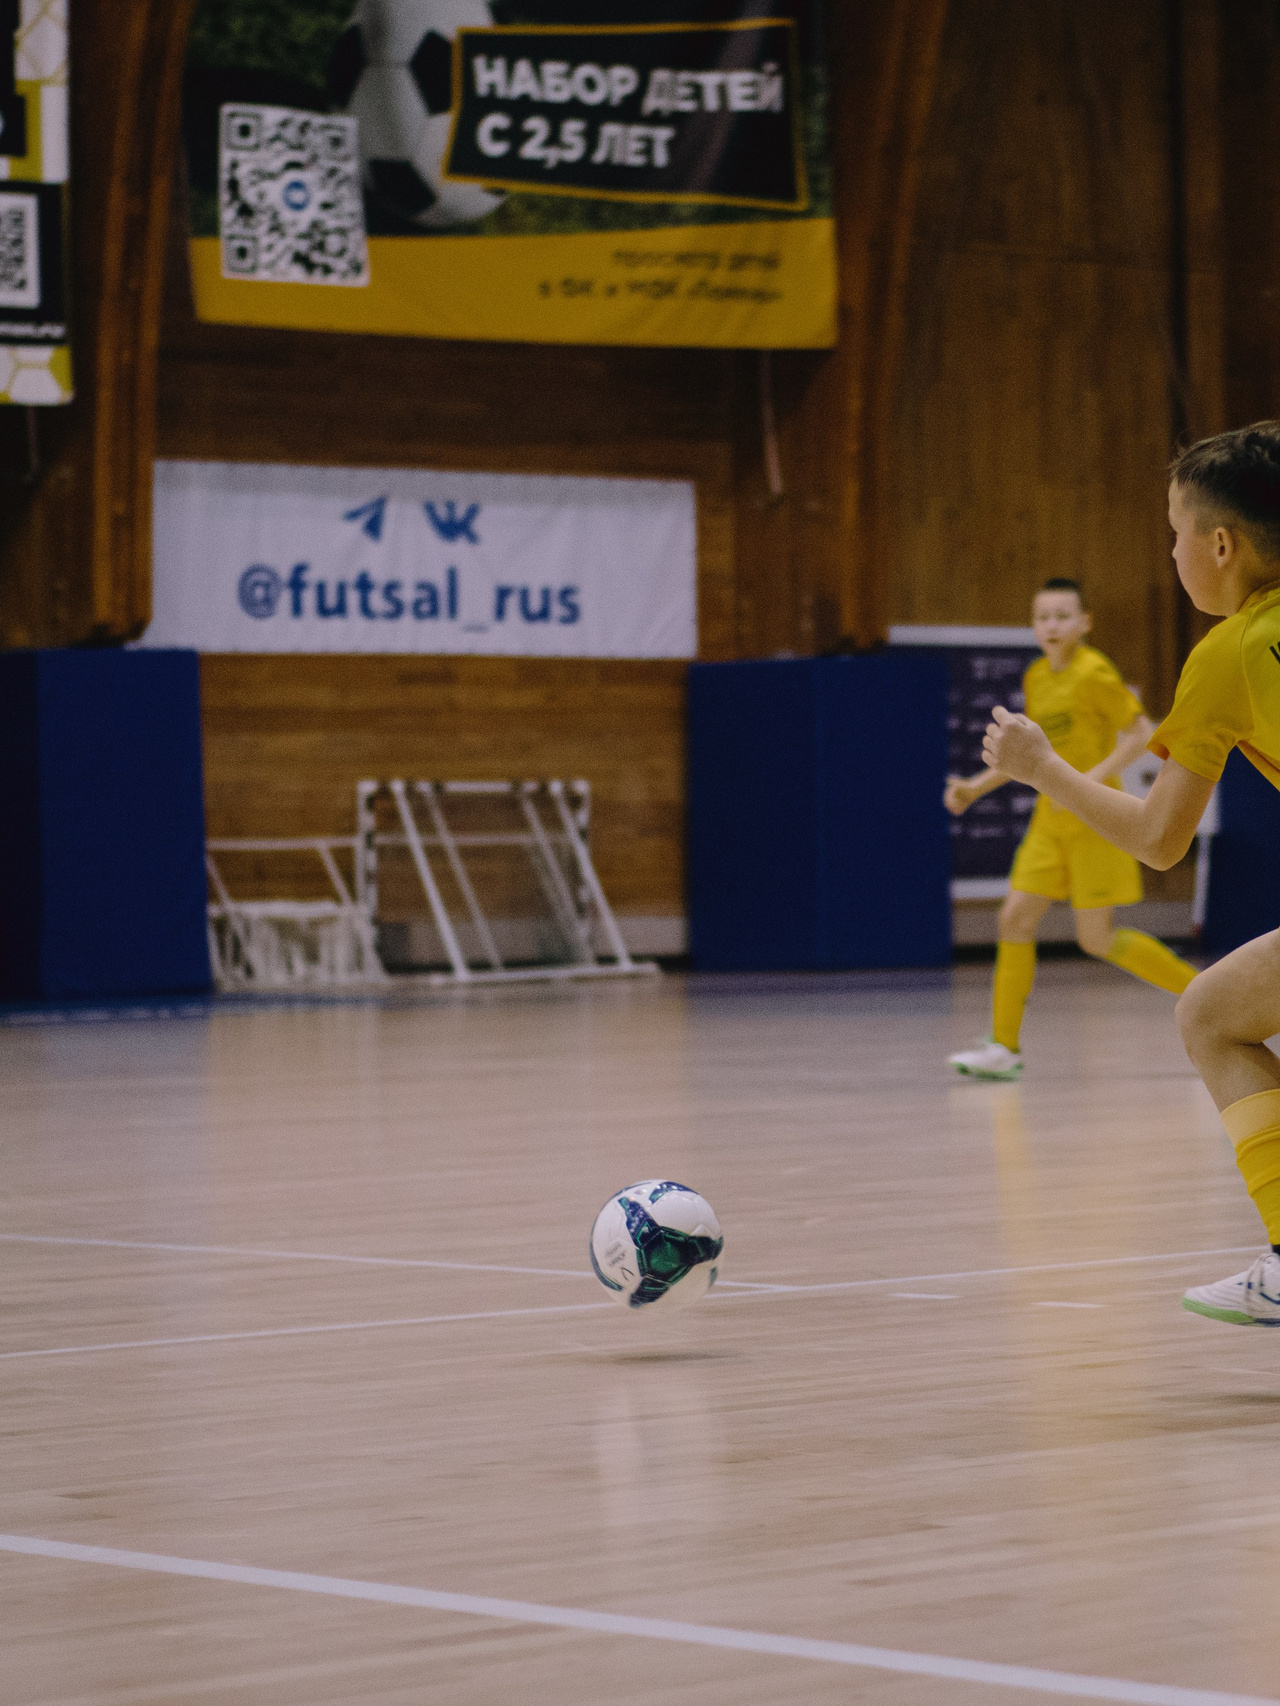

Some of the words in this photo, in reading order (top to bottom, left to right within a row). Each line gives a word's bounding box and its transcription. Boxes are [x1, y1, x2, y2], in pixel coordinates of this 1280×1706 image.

[472, 53, 638, 107] НАБОР
[641, 61, 784, 116] ДЕТЕЙ
[476, 111, 511, 157] С
[519, 115, 587, 169] 2,5
[591, 121, 675, 168] ЛЕТ
[237, 562, 581, 633] @futsal_rus
